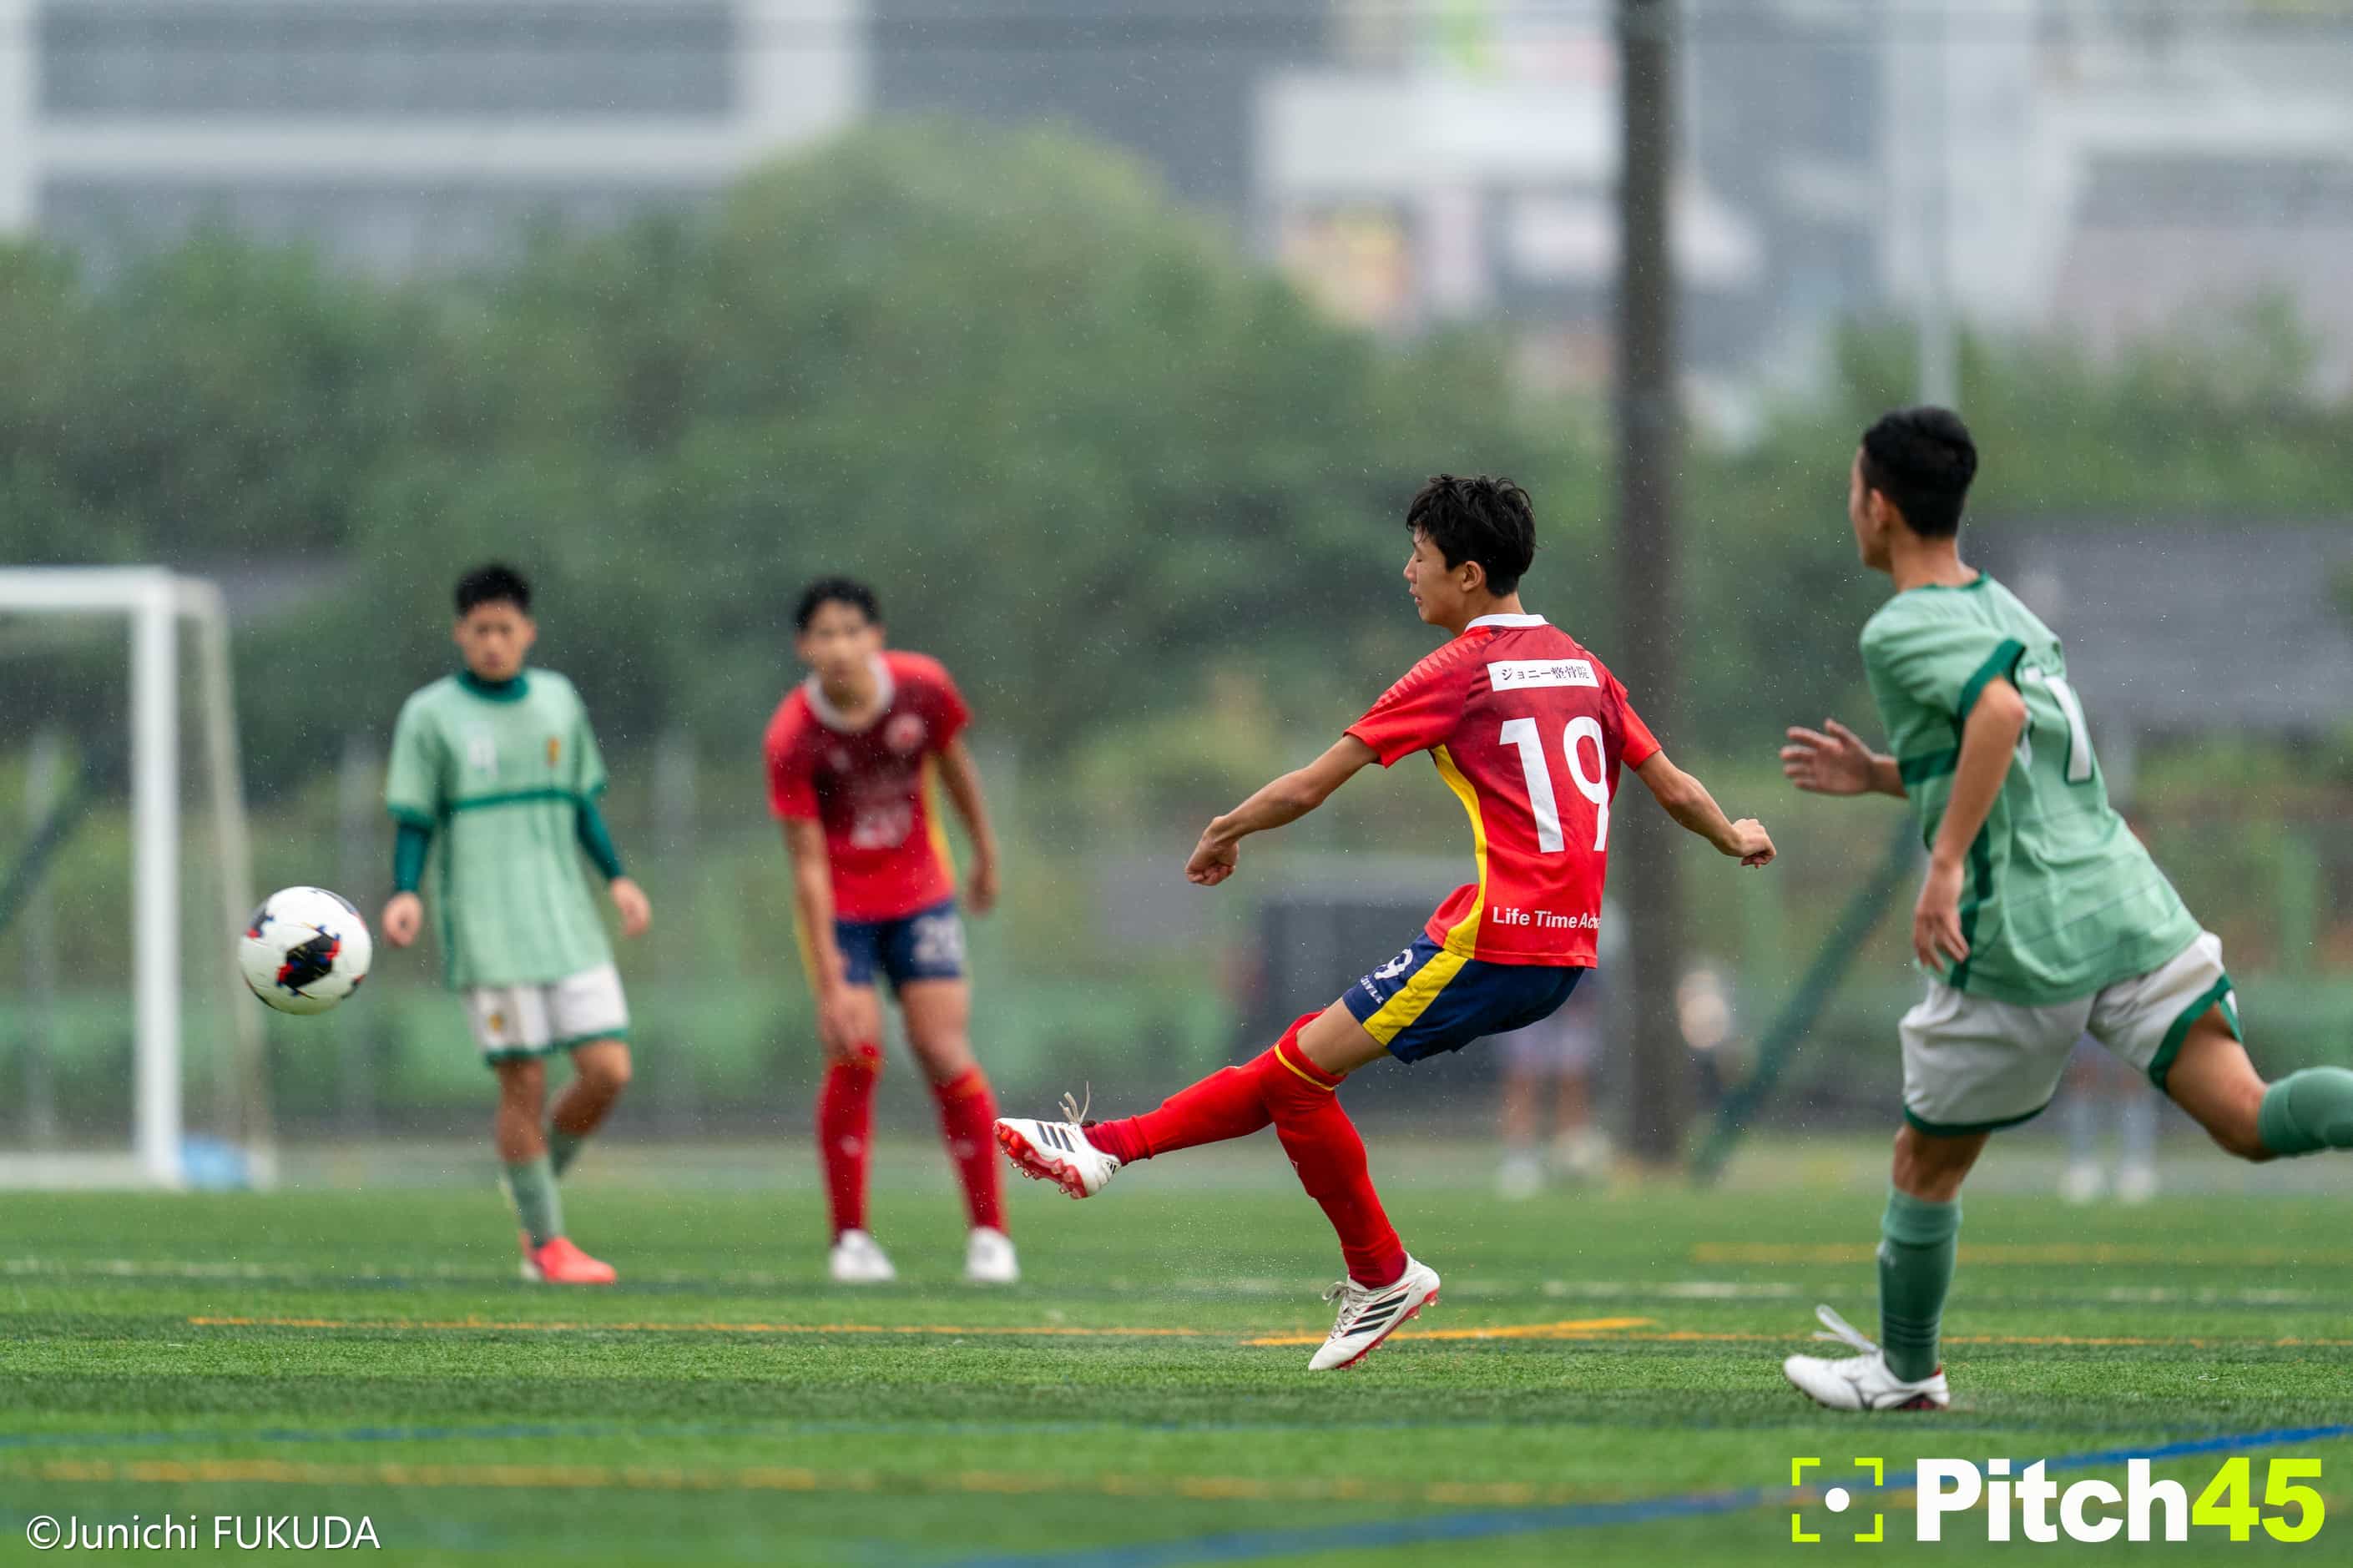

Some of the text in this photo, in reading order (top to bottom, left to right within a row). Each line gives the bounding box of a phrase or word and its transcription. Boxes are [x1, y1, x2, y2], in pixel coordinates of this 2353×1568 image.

[1498, 715, 1611, 854] 19
[1492, 906, 1531, 925] Life
[1534, 910, 1578, 929] Time
